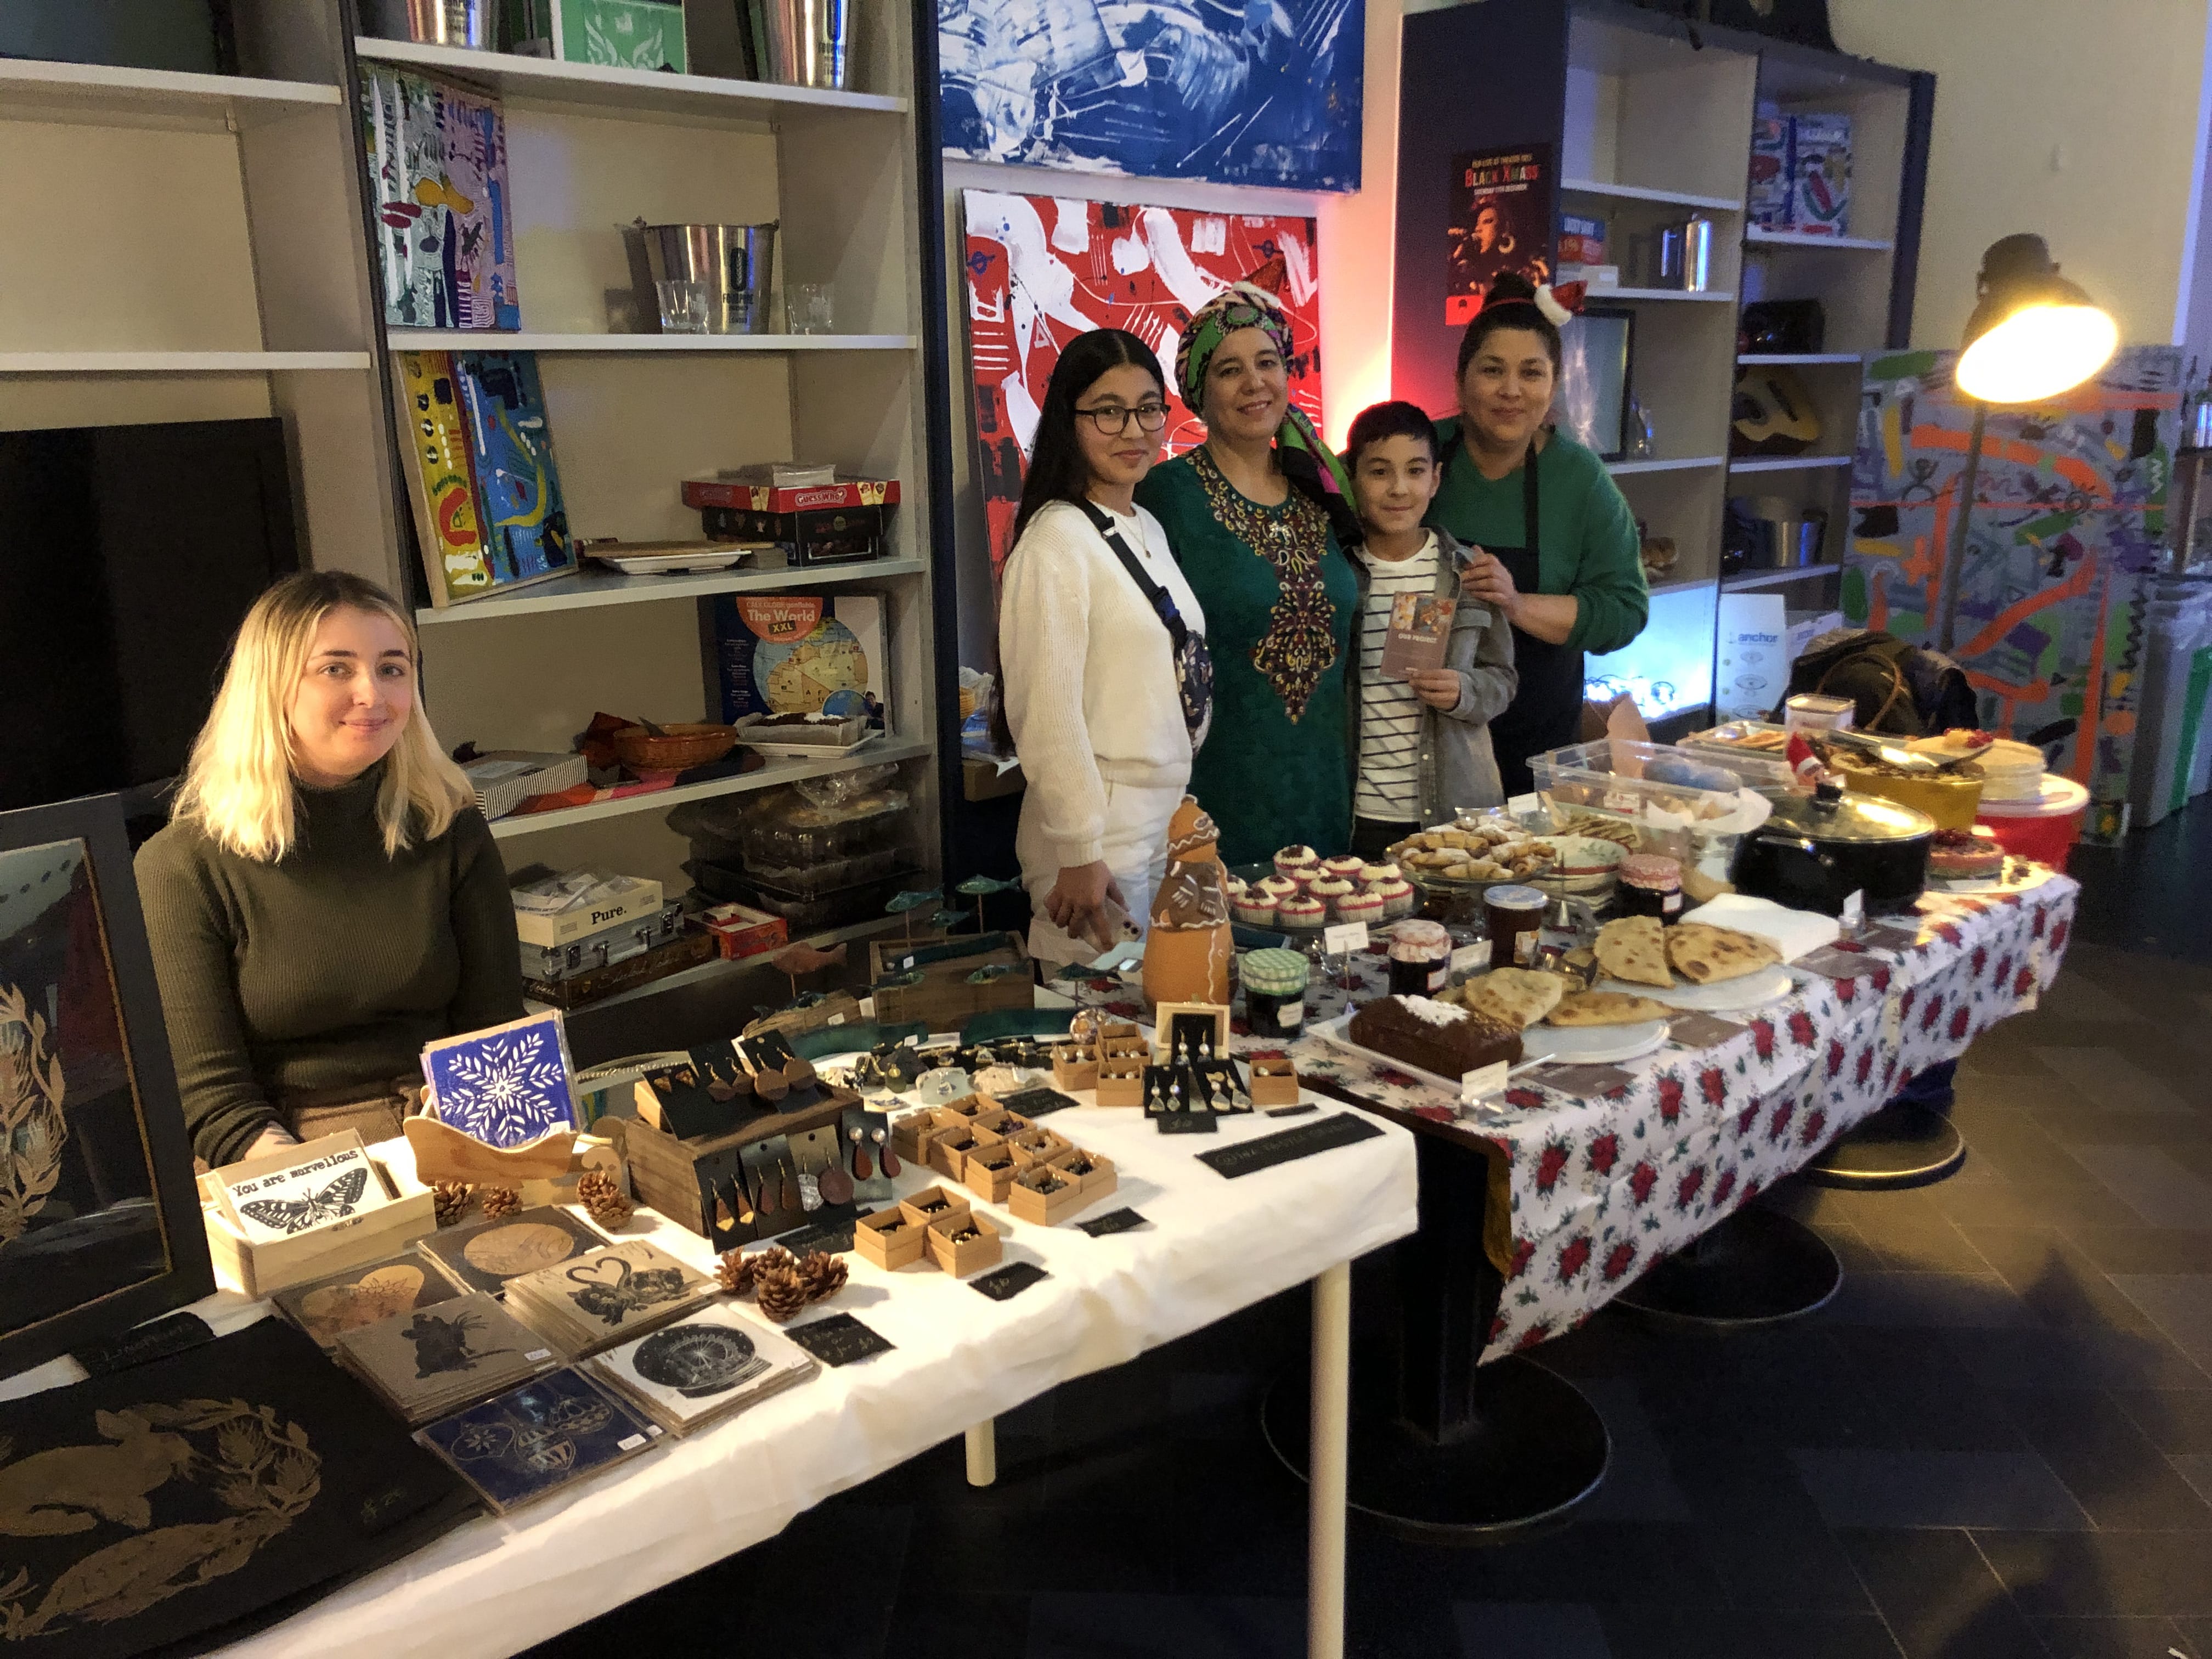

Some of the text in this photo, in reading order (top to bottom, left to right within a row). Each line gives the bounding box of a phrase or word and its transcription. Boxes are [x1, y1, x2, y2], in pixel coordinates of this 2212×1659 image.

[1465, 168, 1498, 188] BLACK
[747, 609, 815, 622] The World
[773, 623, 793, 633] XXL
[1412, 635, 1437, 644] PROJECT
[1738, 632, 1778, 643] anchor
[591, 906, 627, 925] Pure.
[232, 1150, 359, 1197] You are marvellous
